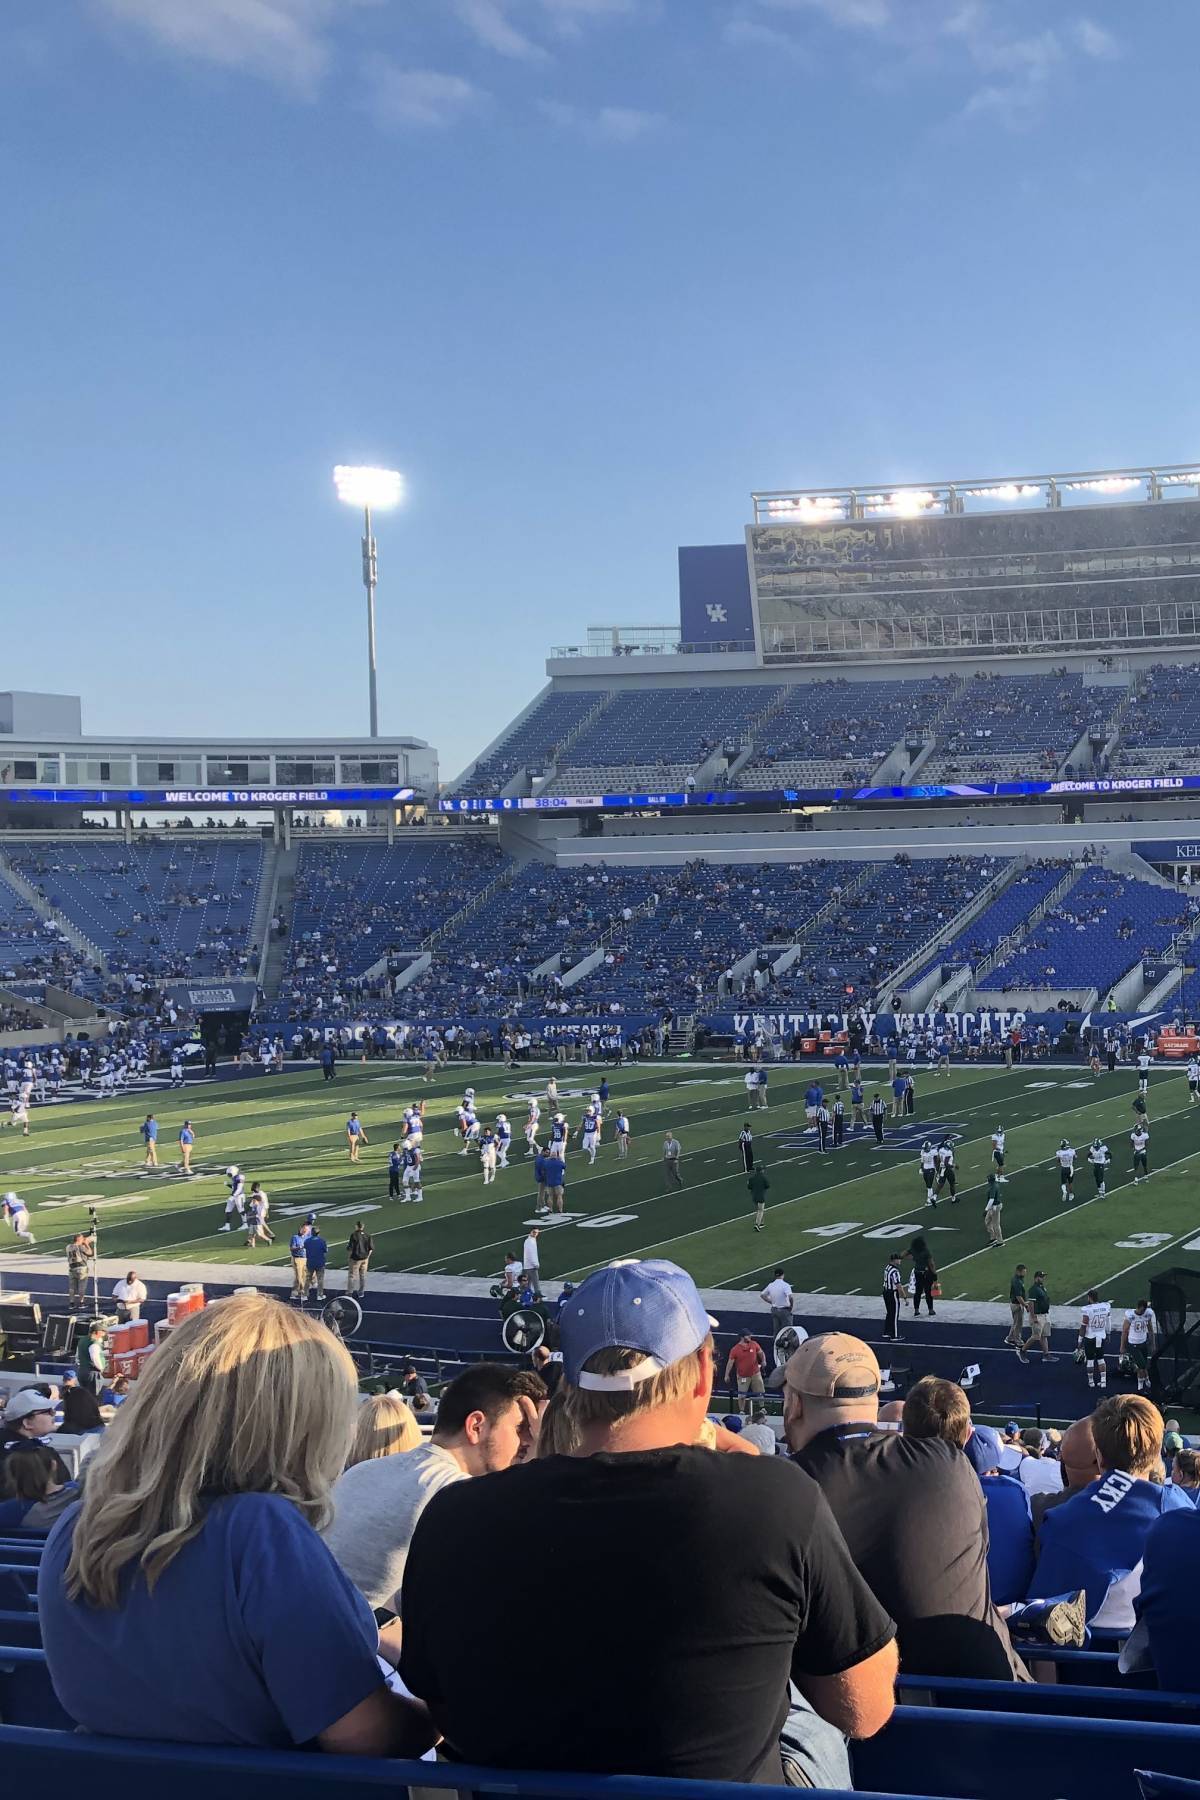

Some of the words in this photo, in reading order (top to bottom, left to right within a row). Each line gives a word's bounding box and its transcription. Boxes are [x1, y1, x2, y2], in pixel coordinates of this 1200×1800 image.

[1051, 780, 1095, 792] WELCOME
[1097, 780, 1110, 790] TO
[1112, 779, 1152, 790] KROGER
[1154, 778, 1184, 789] FIELD
[165, 792, 229, 802] WELCOME
[231, 791, 248, 802] TO
[250, 791, 297, 801] KROGER
[299, 791, 328, 801] FIELD
[534, 797, 568, 808] 38:04
[801, 1222, 924, 1239] 40
